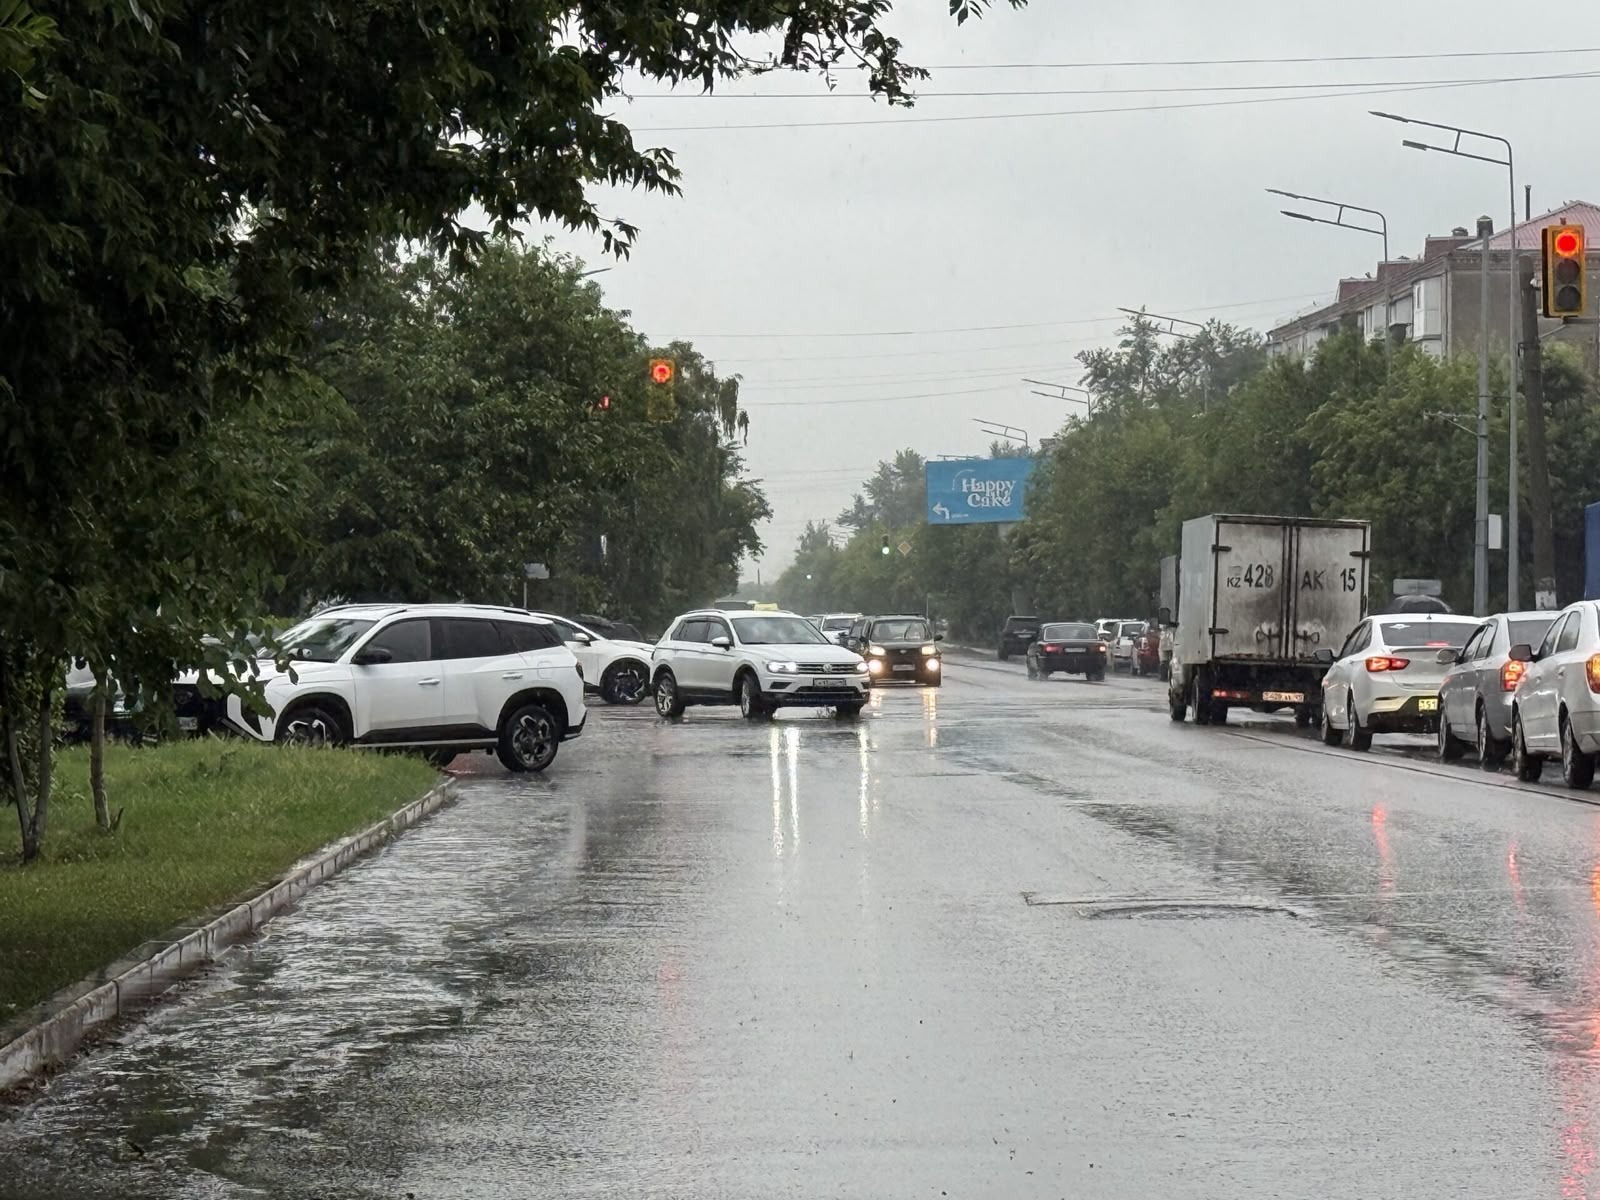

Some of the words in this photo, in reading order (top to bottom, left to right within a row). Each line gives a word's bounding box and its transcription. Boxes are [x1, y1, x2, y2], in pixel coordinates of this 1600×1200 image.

[961, 478, 1017, 497] Happy
[967, 491, 1012, 508] Cake
[1227, 576, 1241, 588] KZ
[1244, 563, 1274, 588] 428
[1340, 567, 1356, 592] 15
